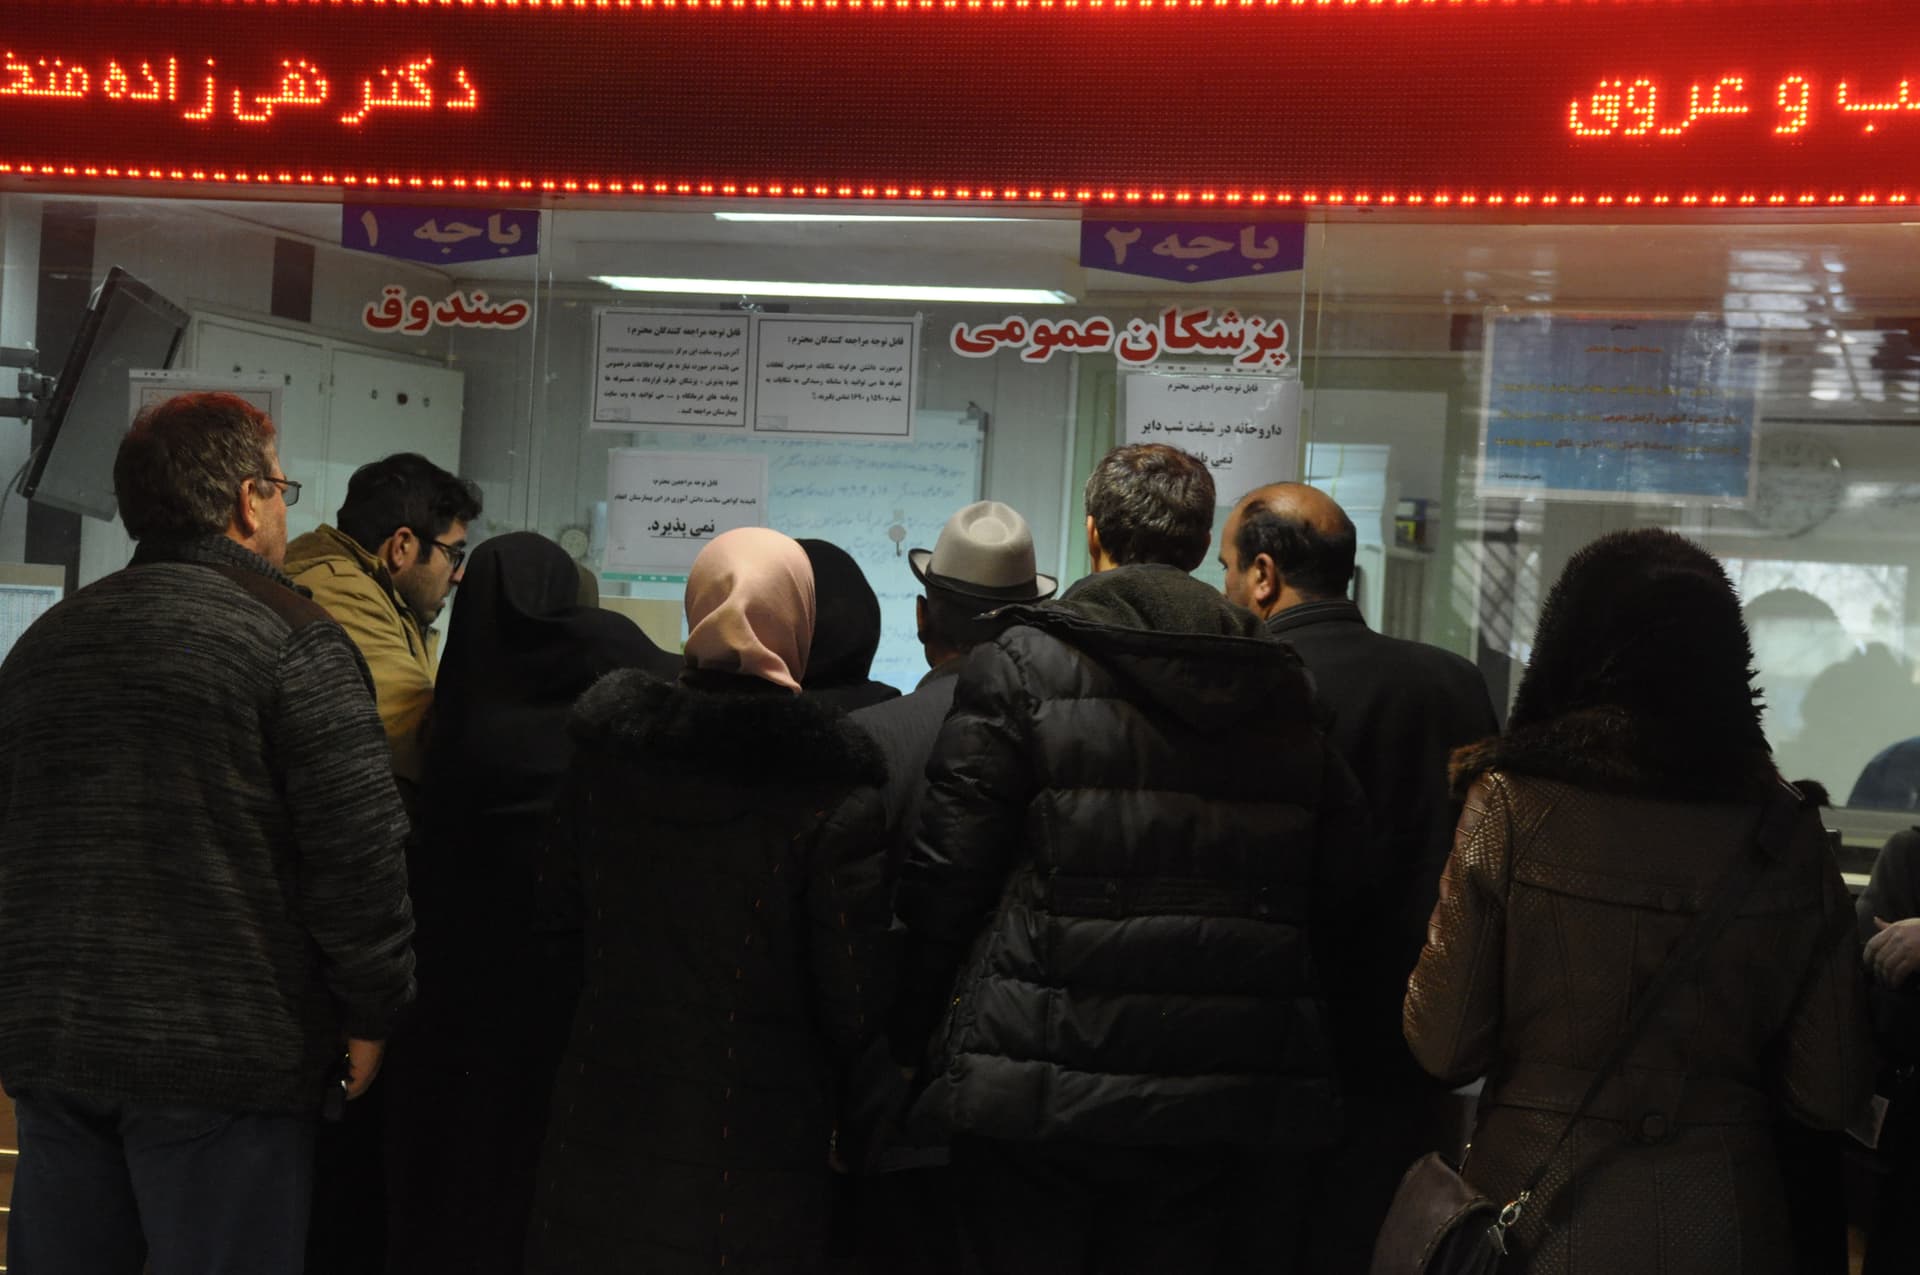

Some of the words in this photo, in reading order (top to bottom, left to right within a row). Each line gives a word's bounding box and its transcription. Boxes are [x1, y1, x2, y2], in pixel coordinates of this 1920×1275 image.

[103, 58, 216, 120] زاده
[340, 56, 477, 123] دکتر
[1568, 75, 1749, 137] عروق
[1774, 75, 1810, 135] و
[361, 210, 378, 247] ۱
[413, 212, 521, 254] باجه
[1104, 226, 1142, 265] ۲
[1152, 225, 1280, 271] باجه
[364, 286, 530, 333] صندوق
[953, 317, 1112, 361] عمومی
[1116, 308, 1289, 367] پزشکان
[1191, 383, 1222, 393] مراجعین
[1224, 384, 1241, 394] توجه
[1243, 383, 1258, 394] قابل
[1140, 419, 1162, 435] دایر
[1164, 420, 1184, 435] شب
[1186, 421, 1215, 436] شیفت
[1217, 424, 1231, 437] در
[1234, 422, 1283, 439] داروخانه
[1210, 452, 1233, 468] نمی
[689, 519, 715, 537] نمی
